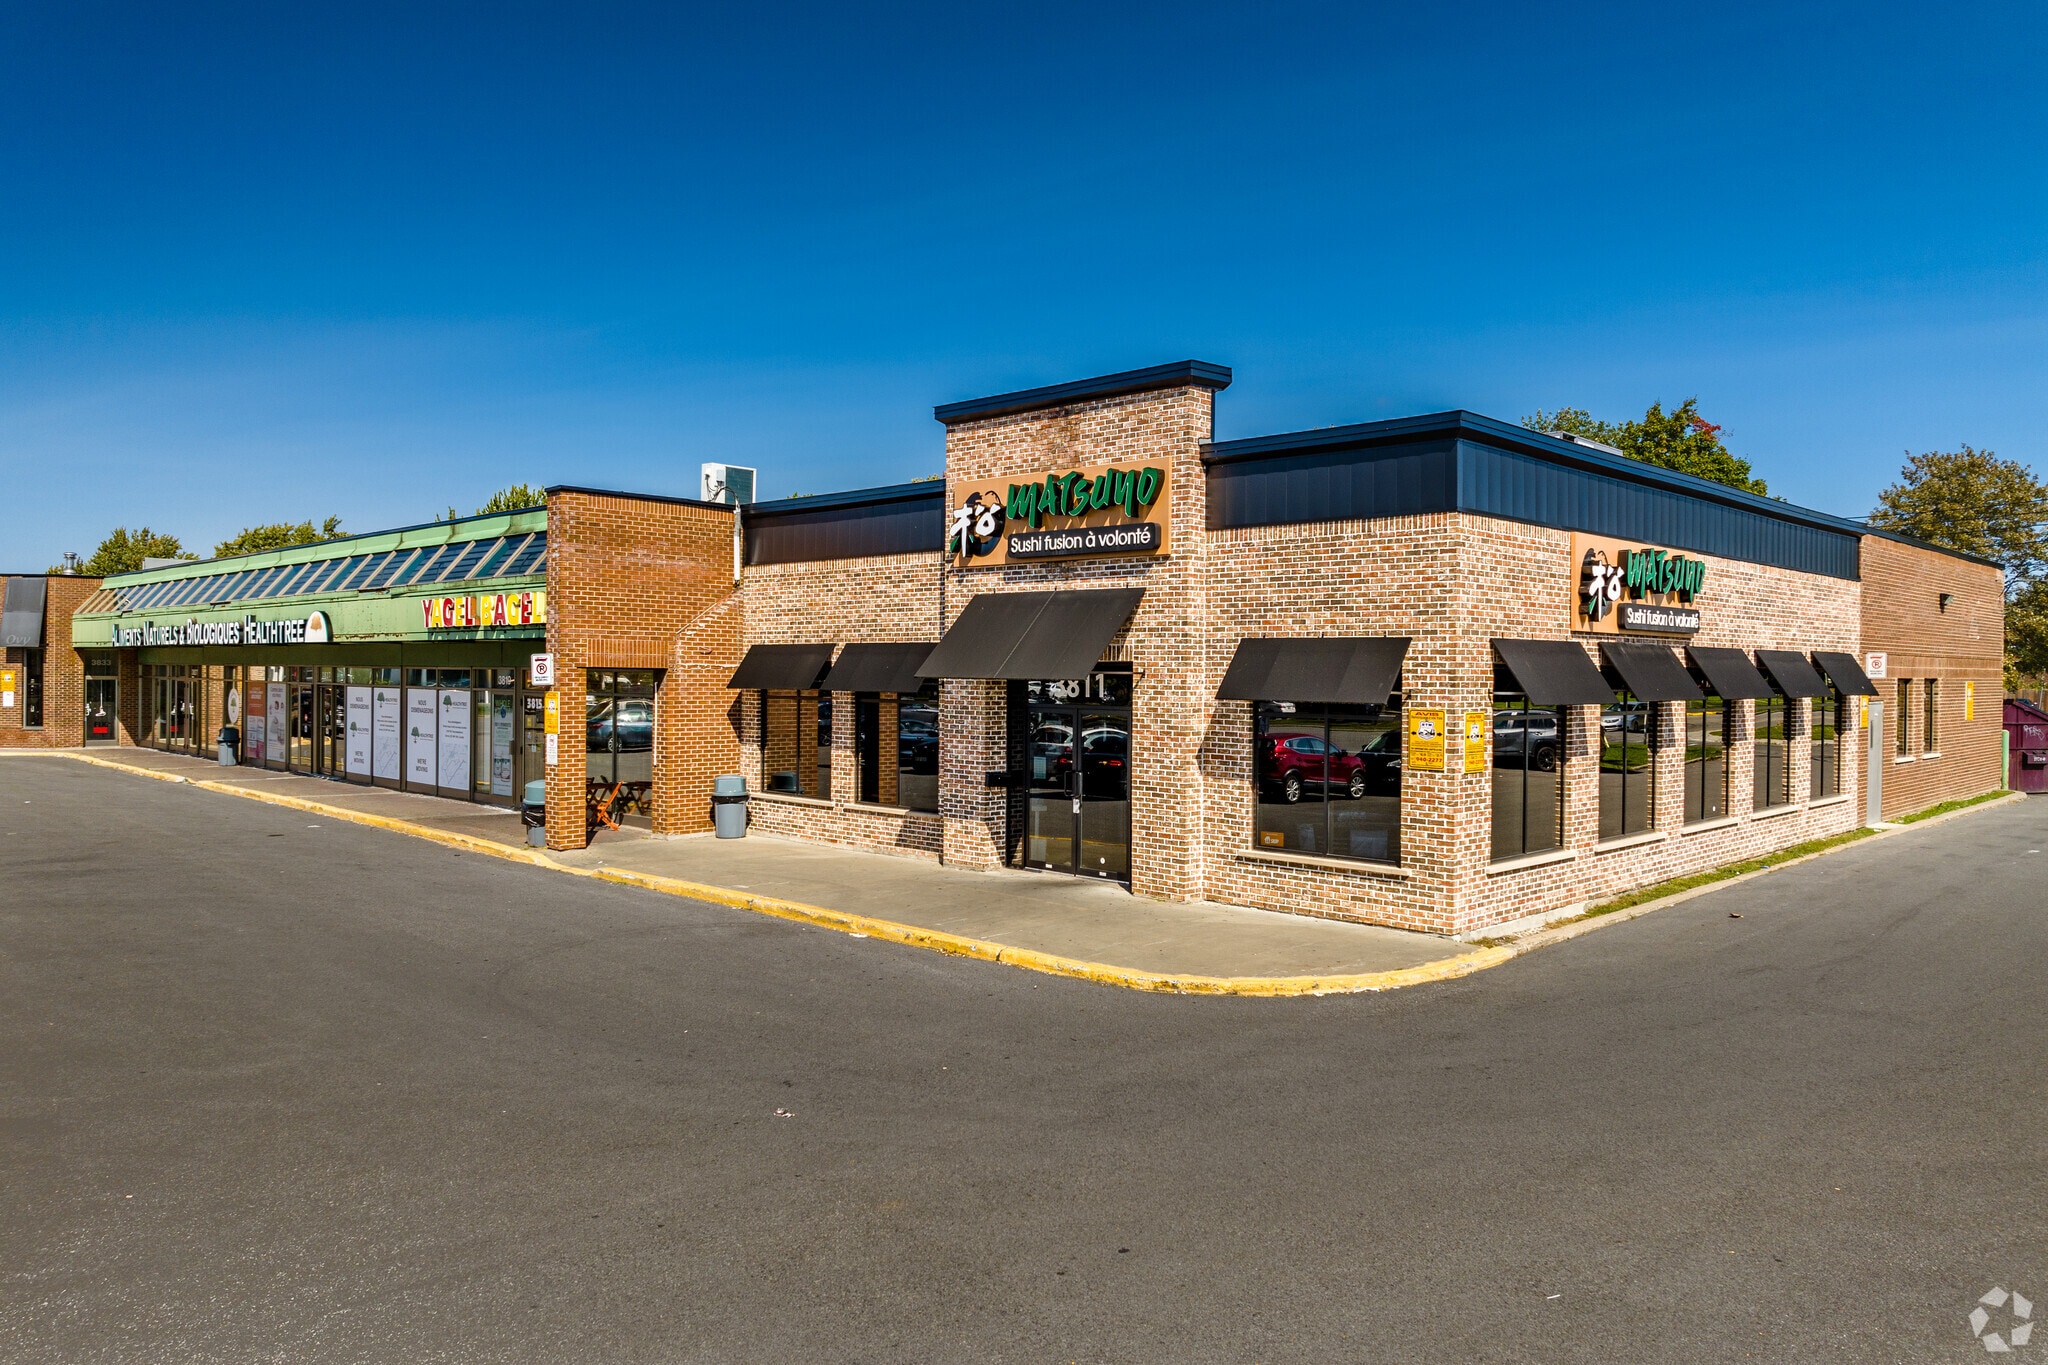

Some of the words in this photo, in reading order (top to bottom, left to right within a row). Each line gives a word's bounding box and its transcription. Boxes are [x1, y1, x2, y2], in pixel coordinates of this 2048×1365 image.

[1010, 534, 1042, 553] Sushi
[1044, 533, 1083, 551] fusion
[1087, 530, 1096, 548] à
[1098, 526, 1151, 548] volonté
[421, 596, 474, 628] YAGEL
[480, 592, 546, 626] BAGEL
[1627, 607, 1647, 624] Sushi
[1646, 609, 1668, 626] fusion
[1669, 611, 1674, 627] à
[1674, 613, 1699, 629] volonté
[111, 623, 142, 647] ALIMENTS
[143, 620, 178, 646] NATURELS
[179, 625, 185, 644] &
[187, 618, 240, 645] BIOLOGIQUES
[244, 614, 305, 644] HEALTHTREE
[526, 698, 543, 710] 3815
